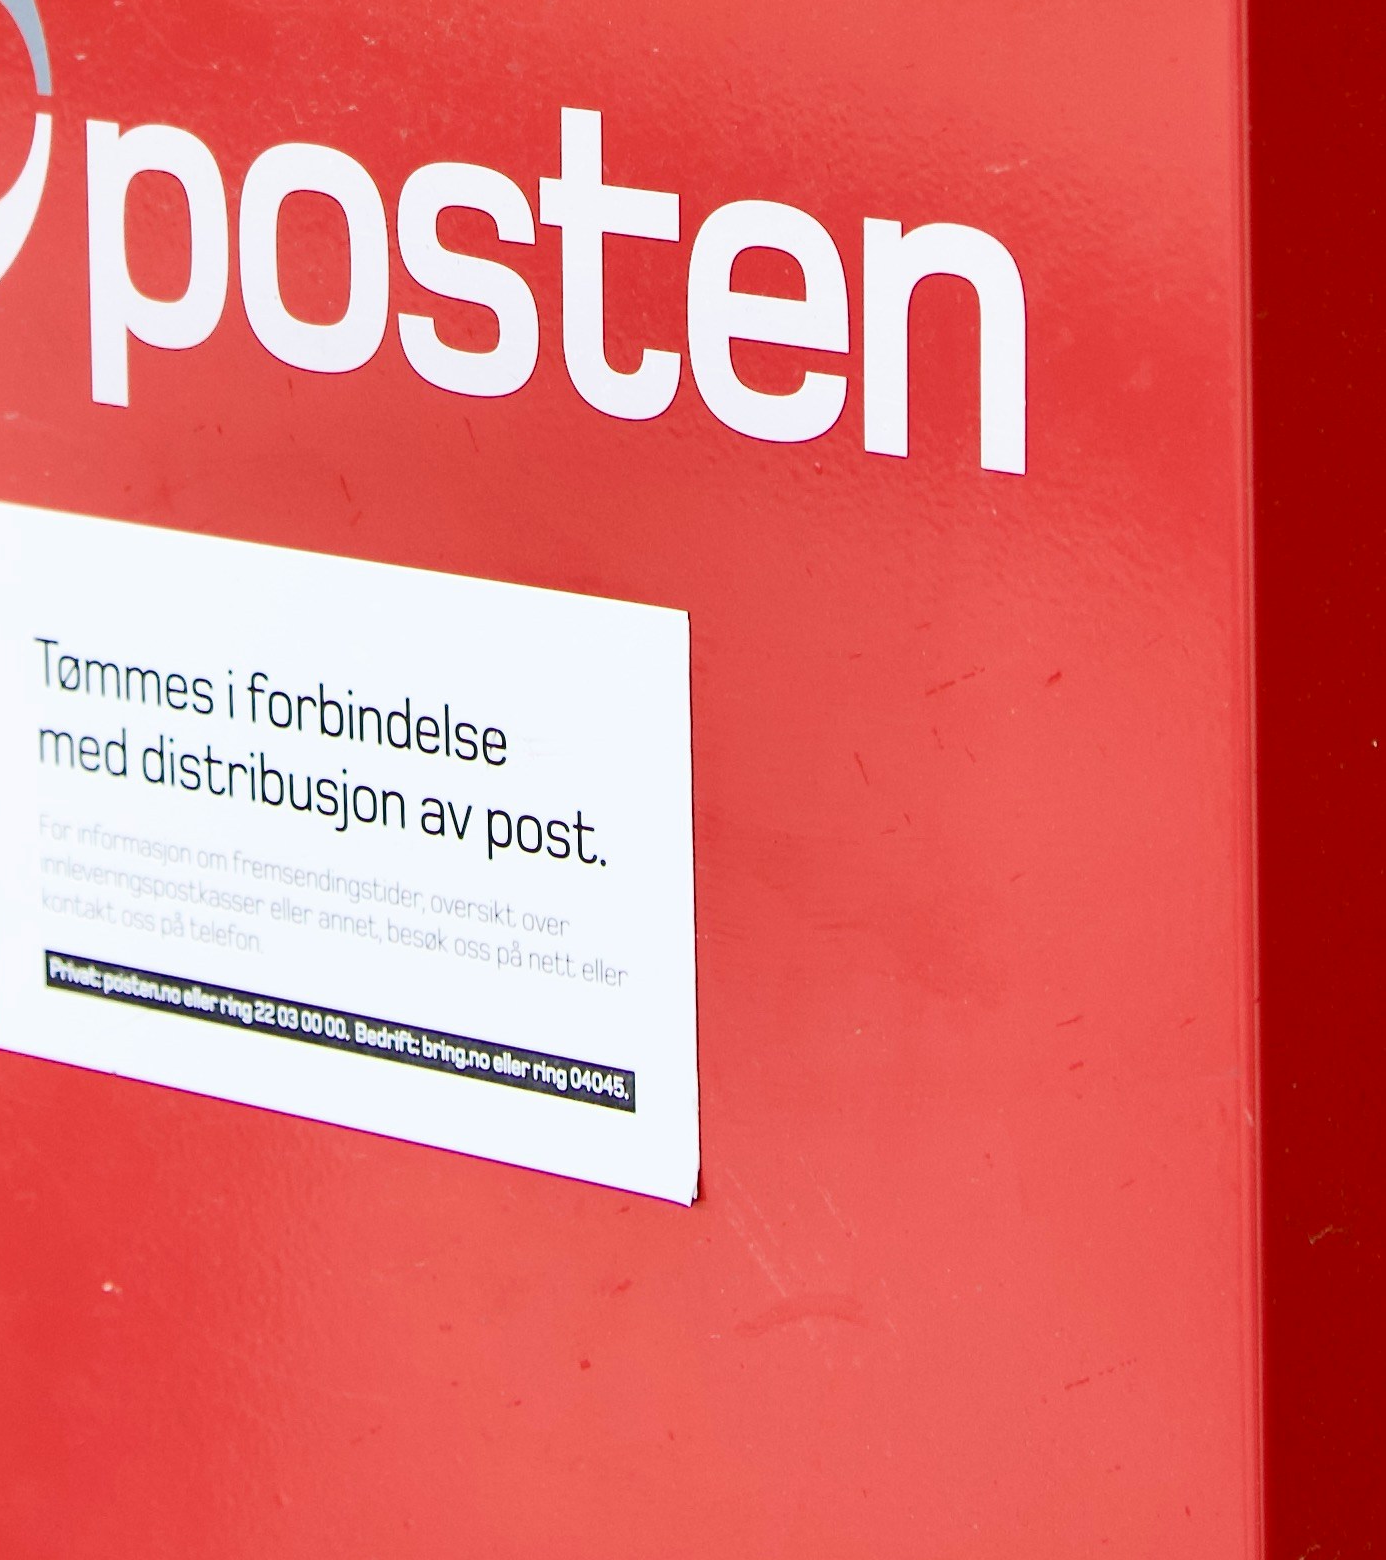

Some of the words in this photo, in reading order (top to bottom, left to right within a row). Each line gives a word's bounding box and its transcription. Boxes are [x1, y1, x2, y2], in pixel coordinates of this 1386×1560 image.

[85, 106, 1027, 476] posten
[33, 636, 215, 717] Tømmes
[226, 670, 235, 720] i
[247, 671, 508, 767] forbindelse
[38, 723, 128, 779] med
[141, 736, 406, 833] distribusjon
[420, 799, 473, 842] av
[486, 807, 607, 867] post.
[39, 813, 72, 841] For
[76, 823, 193, 867] informasjon
[197, 848, 228, 872] om
[232, 850, 426, 914] fremsendingstider,
[430, 893, 517, 929] oversikt
[521, 912, 571, 937] over
[40, 855, 266, 916] innleveringspostkasser
[270, 897, 313, 926] eller
[318, 909, 383, 945] annet,
[387, 917, 449, 953] besøk
[453, 936, 491, 962] oss
[496, 940, 523, 971] på
[528, 951, 577, 979] nett
[581, 957, 629, 988] eller
[41, 887, 117, 924] kontakt
[121, 907, 155, 932] oss
[160, 911, 185, 938] på
[190, 916, 265, 954] telefon.
[102, 971, 182, 1005] posten.no
[183, 985, 218, 1013] eller
[219, 994, 254, 1025] ring
[254, 999, 276, 1026] 22
[277, 1004, 300, 1031] 03
[300, 1009, 323, 1035] 00
[324, 1014, 351, 1042] 00.
[354, 1020, 421, 1056] Bedrift:
[421, 1034, 491, 1071] bring.no
[492, 1051, 531, 1079] eller
[532, 1060, 568, 1092] ring
[569, 1066, 630, 1102] 04045.
